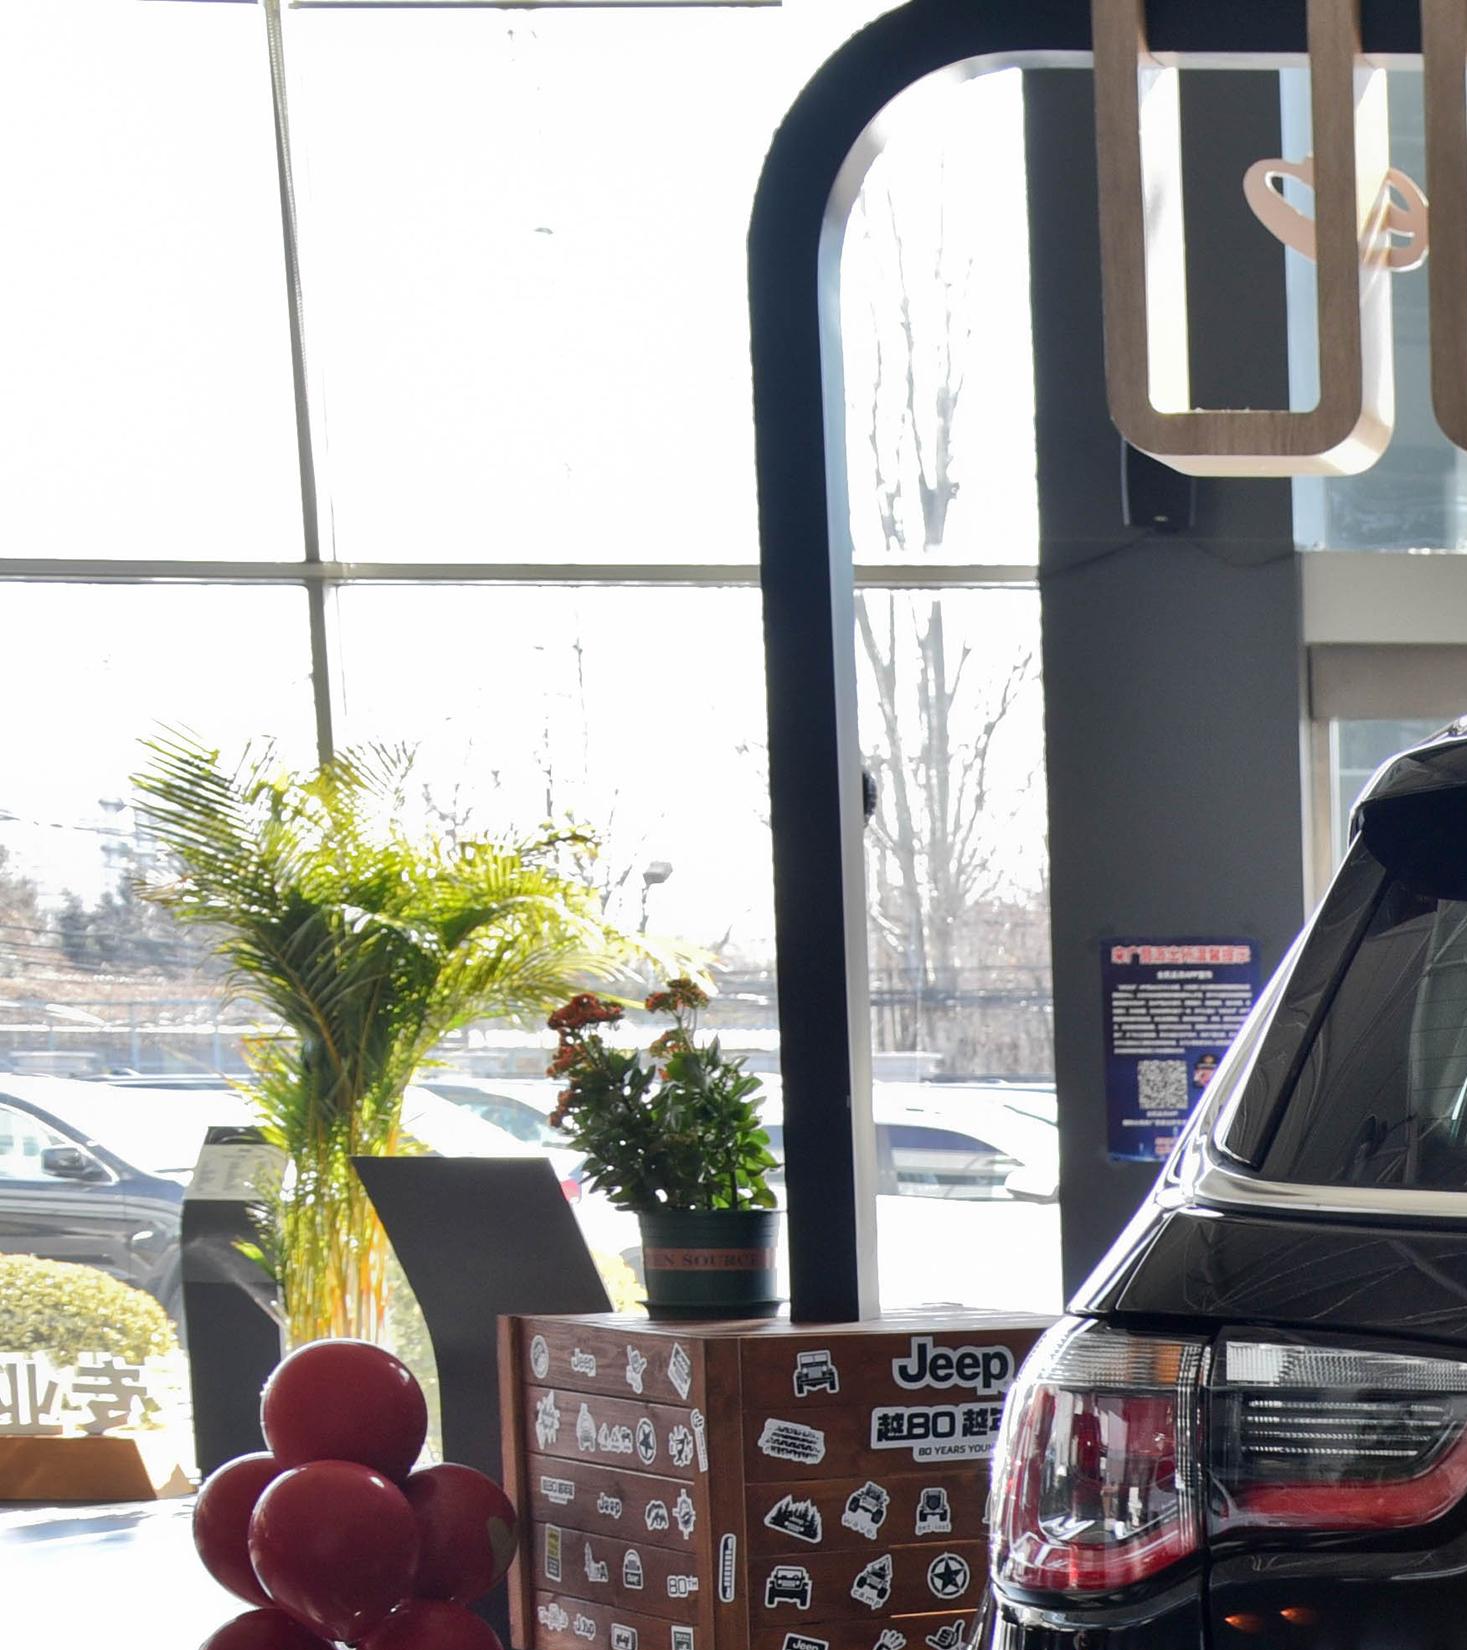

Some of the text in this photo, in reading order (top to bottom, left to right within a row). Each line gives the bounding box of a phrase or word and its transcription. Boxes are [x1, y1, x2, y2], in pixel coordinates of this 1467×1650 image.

[899, 1342, 1009, 1389] Jeep
[876, 1410, 956, 1442] 越80
[934, 1445, 966, 1455] YEARS
[852, 1588, 882, 1609] camp
